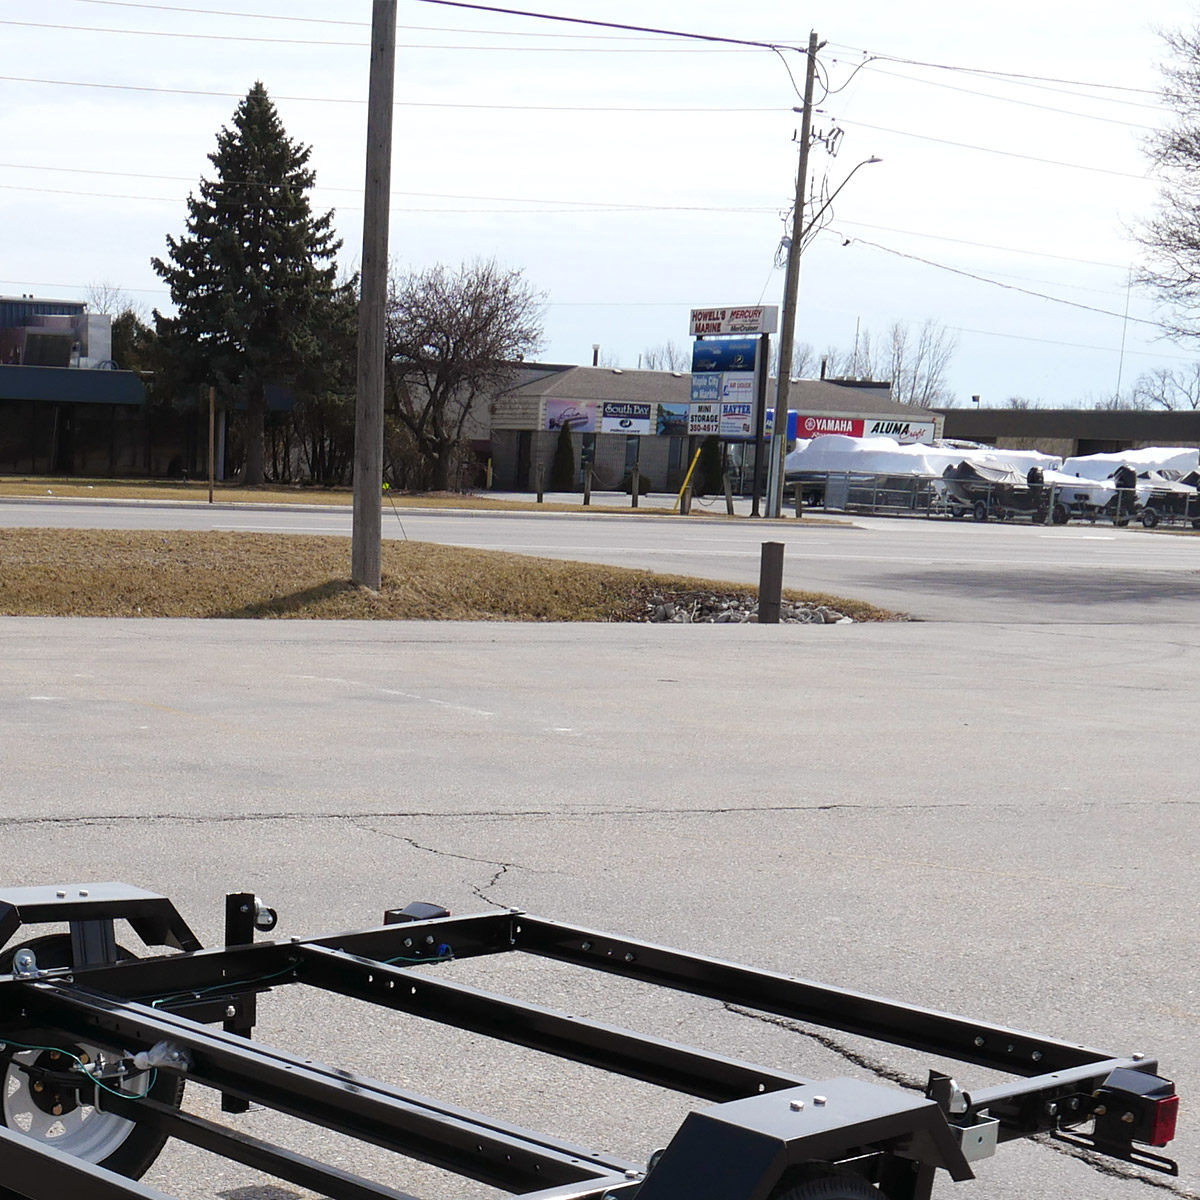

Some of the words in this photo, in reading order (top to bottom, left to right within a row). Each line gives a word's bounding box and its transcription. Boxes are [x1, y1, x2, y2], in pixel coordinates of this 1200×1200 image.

[692, 310, 726, 321] HOWELL'S
[729, 309, 762, 319] MERCURY
[695, 322, 721, 333] MARINE
[605, 404, 633, 414] South
[698, 405, 711, 413] MINI
[723, 405, 751, 414] HAYTER
[691, 415, 718, 423] STORAGE
[816, 419, 853, 432] YAMAHA
[871, 422, 910, 435] ALUMA
